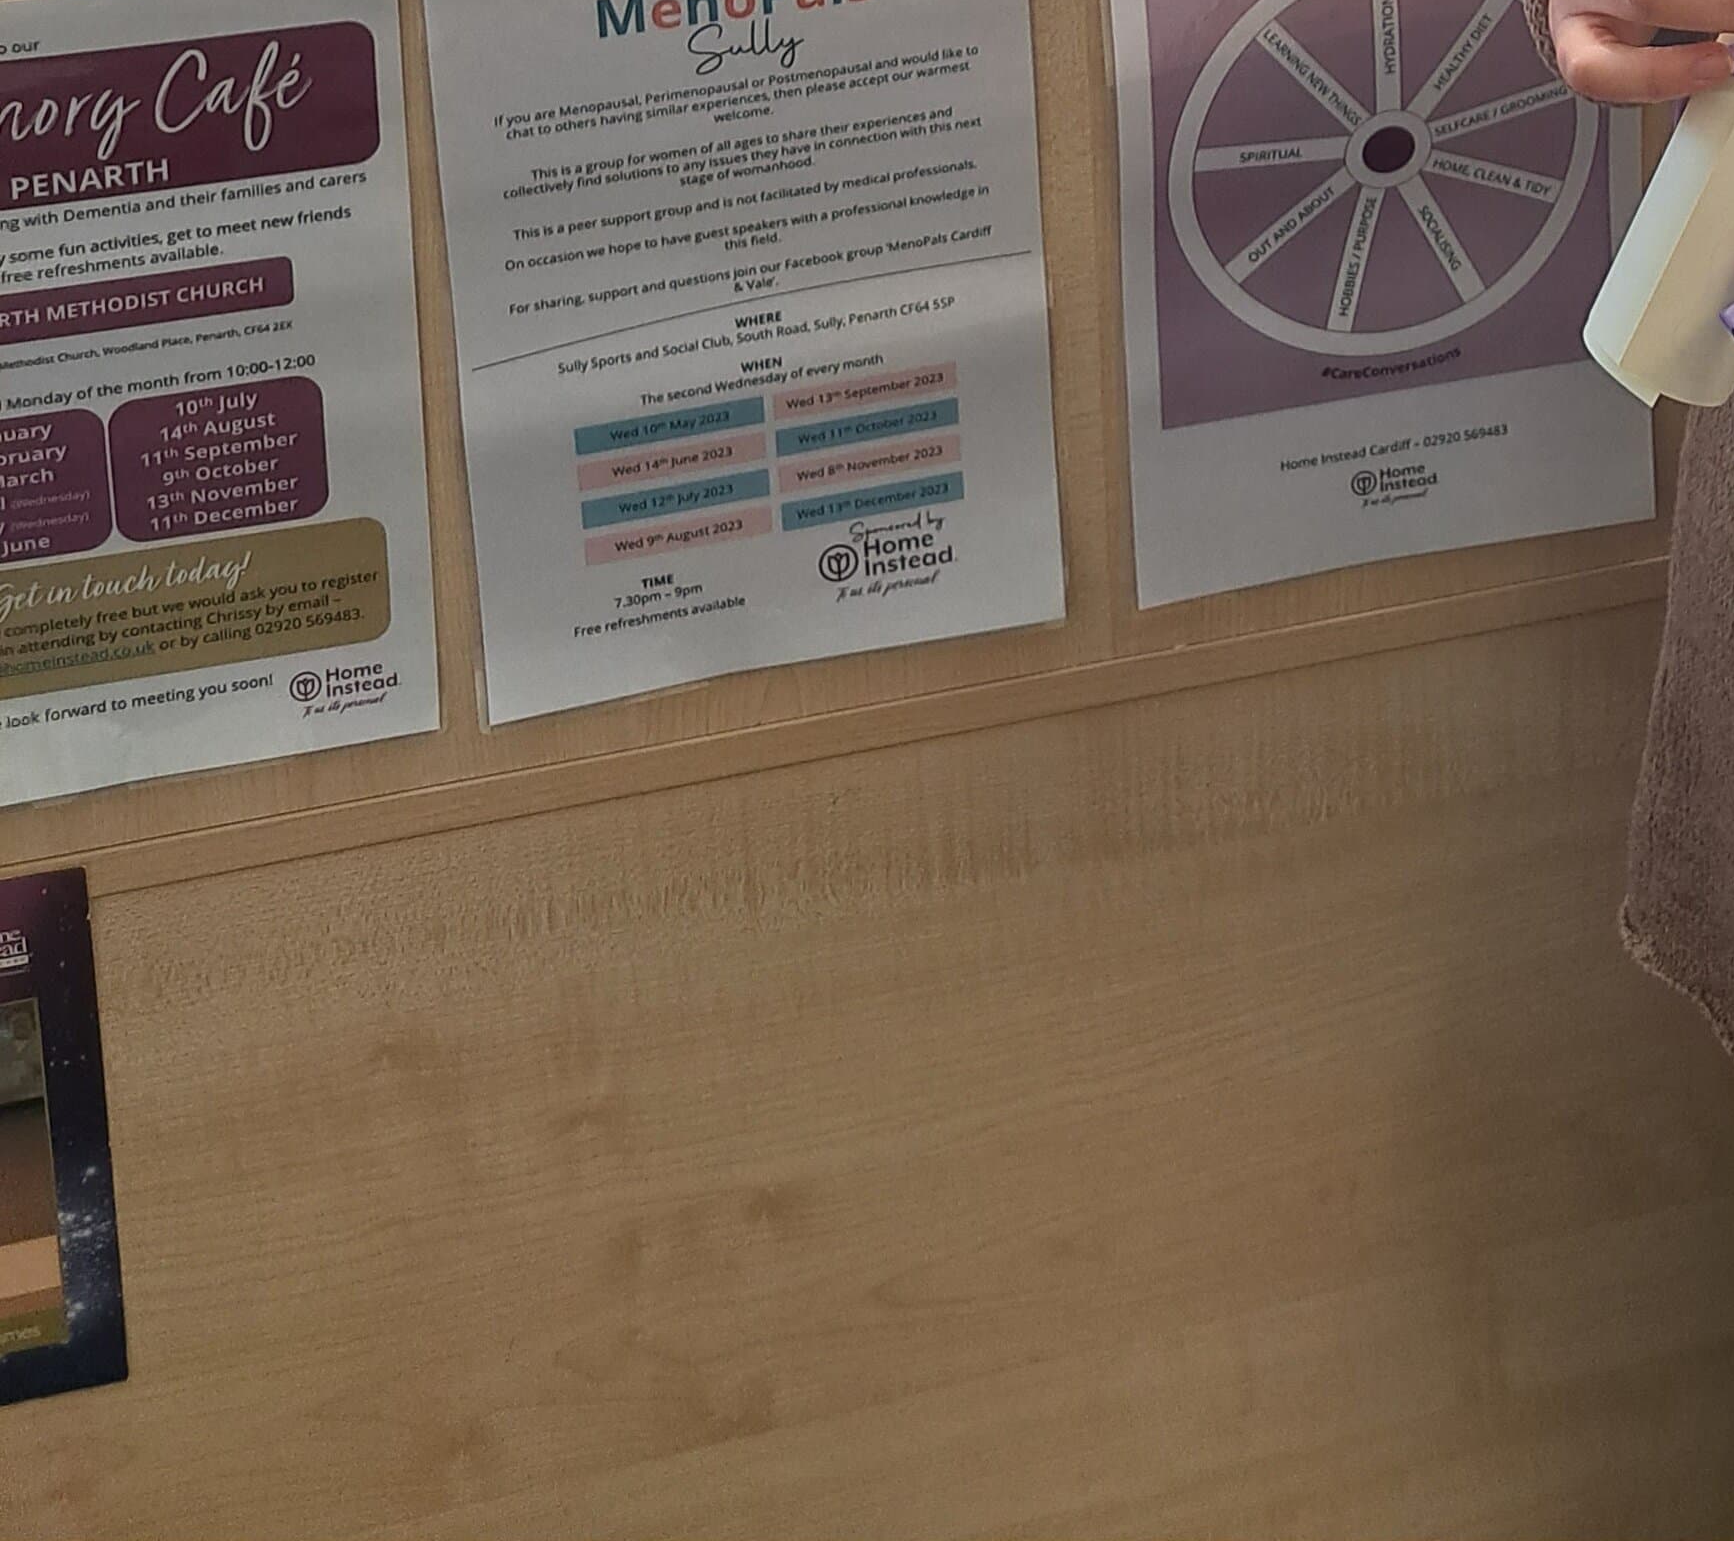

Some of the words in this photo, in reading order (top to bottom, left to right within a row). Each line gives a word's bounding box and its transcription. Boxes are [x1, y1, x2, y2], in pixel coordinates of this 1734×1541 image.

[12, 40, 40, 54] our
[687, 18, 805, 75] Sully
[1434, 41, 1473, 92] HEALTHY
[1470, 12, 1493, 42] DIET
[0, 88, 141, 160] ory
[154, 40, 312, 152] Café
[1239, 148, 1303, 163] SPIRITUAL
[10, 158, 170, 201] PENARTH
[21, 209, 59, 227] with
[62, 200, 142, 223] Dementia
[144, 193, 176, 212] and
[178, 189, 218, 208] their
[219, 182, 282, 203] families
[284, 174, 315, 193] and
[317, 171, 368, 189] carers
[9, 247, 55, 264] some
[57, 241, 86, 258] fun
[88, 232, 163, 254] activities,
[165, 227, 193, 247] get
[194, 225, 213, 239] to
[215, 217, 257, 237] meet
[259, 214, 295, 230] new
[296, 204, 352, 226] friends
[1248, 239, 1273, 263] OUT
[1273, 218, 1298, 241] AND
[1297, 186, 1336, 222] ABOUT
[1, 267, 33, 286] free
[36, 254, 146, 280] refreshments
[148, 241, 224, 265] available.
[1339, 262, 1361, 317] HOBBIES
[1353, 196, 1378, 251] PURPOSE
[46, 290, 172, 321] METHODIST
[176, 277, 264, 302] CHURCH
[735, 311, 782, 330] WHERE
[556, 357, 589, 375] Sully
[589, 352, 633, 371] Sports
[633, 344, 660, 362] and
[660, 337, 700, 358] Social
[700, 333, 734, 353] Club,
[735, 326, 774, 345] South
[775, 319, 812, 338] Road,
[812, 315, 846, 332] Sully,
[847, 305, 898, 326] Penarth
[898, 300, 930, 316] CF64
[931, 295, 956, 311] 5SP
[7, 391, 73, 410] Monday
[75, 384, 94, 401] of
[95, 383, 123, 398] the
[126, 372, 180, 393] month
[182, 368, 223, 385] from
[225, 352, 316, 379] 10:00-12:00
[638, 391, 665, 408] The
[665, 381, 713, 402] second
[713, 370, 788, 393] Wednesday
[788, 364, 804, 381] of
[804, 361, 841, 378] every
[841, 352, 884, 371] month
[741, 357, 783, 374] WHEN
[1321, 346, 1462, 381] #CareConversations
[1278, 455, 1319, 472] Home
[1319, 444, 1367, 465] Instead
[1368, 436, 1412, 457] Cardiff
[1421, 428, 1462, 448] 02920
[1462, 422, 1509, 442] 569483
[864, 532, 934, 557] Home
[83, 565, 161, 599] touch
[641, 574, 675, 589] TIME
[326, 662, 383, 683] Home
